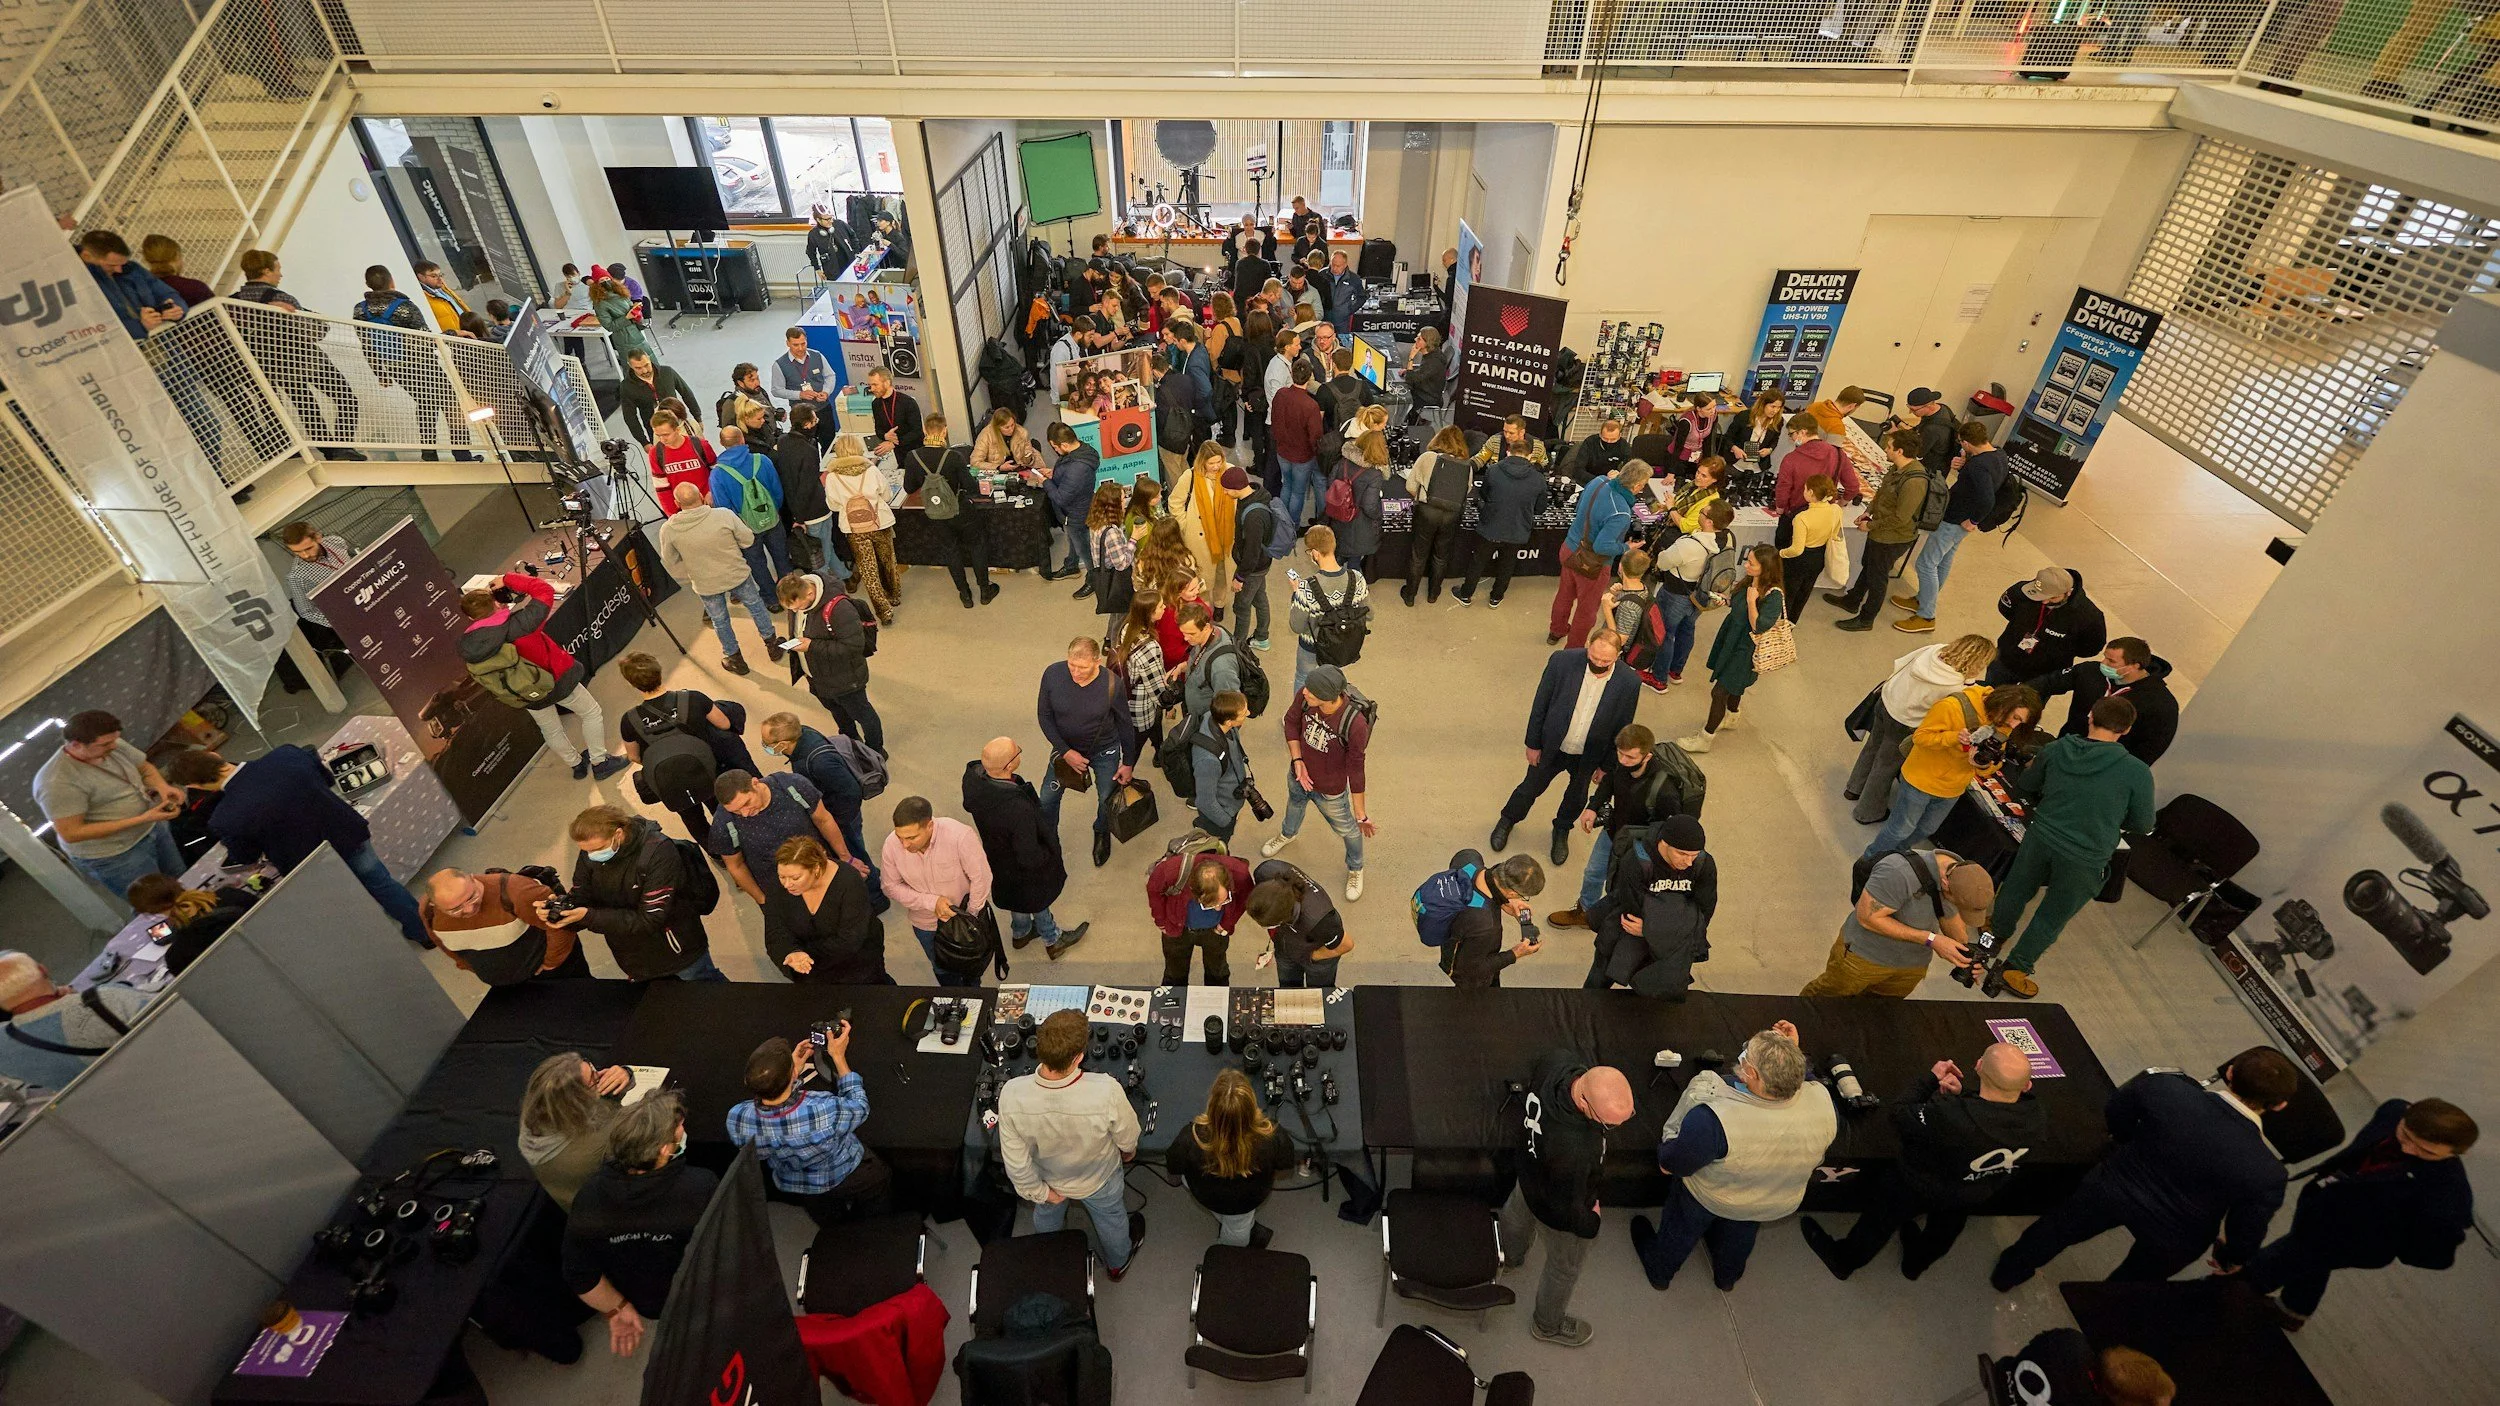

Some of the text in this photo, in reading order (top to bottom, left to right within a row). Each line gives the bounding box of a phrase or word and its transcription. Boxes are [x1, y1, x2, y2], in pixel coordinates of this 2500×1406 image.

[1787, 273, 1847, 287] DELKIN
[1779, 287, 1845, 300] DEVICES
[2084, 294, 2148, 329] DELKIN
[1362, 320, 1417, 331] Saramonic
[2073, 308, 2142, 345] DEVICES
[1470, 334, 1551, 356] ТЕСТ-ДРАЙВ
[2081, 341, 2110, 358] BLACK
[848, 352, 875, 362] instax
[1469, 349, 1548, 370] ОБЪЕКТИВОВ
[1467, 360, 1546, 388] TAMRON
[78, 372, 142, 454] POSSIBLE
[136, 458, 158, 479] OF
[154, 481, 202, 541] FUTURE
[2045, 628, 2066, 638] SONY
[2454, 724, 2496, 755] SONY
[643, 1231, 672, 1242] PAZA
